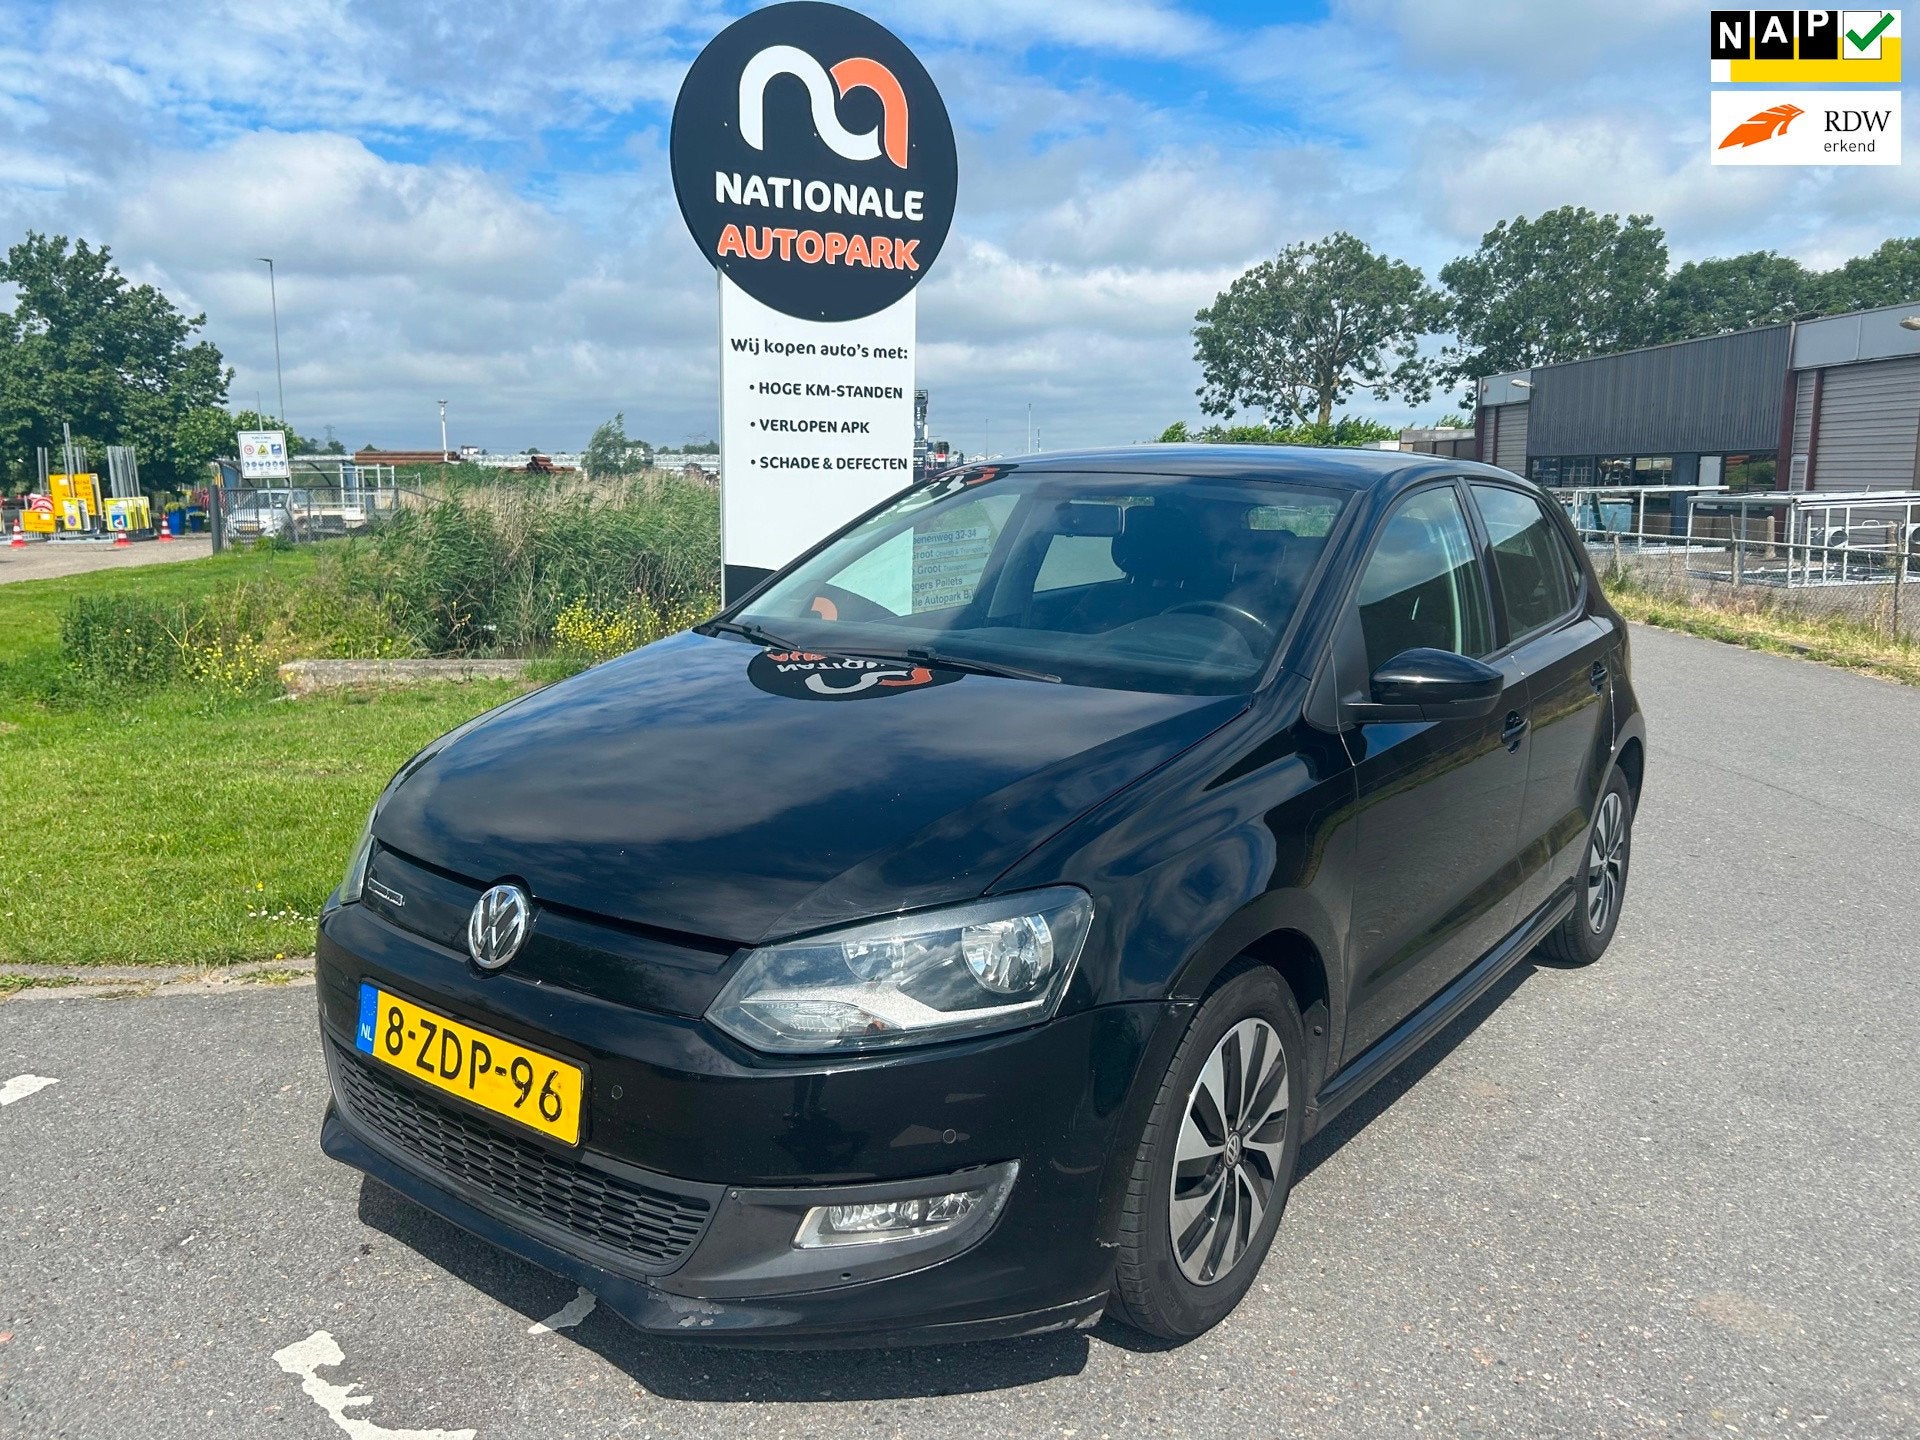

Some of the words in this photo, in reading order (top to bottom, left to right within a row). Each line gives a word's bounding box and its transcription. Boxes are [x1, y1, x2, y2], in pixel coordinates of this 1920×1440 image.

[715, 171, 924, 221] NATIONALE
[717, 223, 921, 271] AUTOPARK
[730, 337, 760, 356] Wij
[764, 339, 816, 357] kopen
[820, 343, 869, 358] auto's
[873, 346, 908, 360] met:
[758, 381, 802, 396] HOGE
[805, 383, 903, 399] KM-STANDEN
[759, 418, 838, 433] VERLOPEN
[840, 420, 870, 434] APK
[759, 456, 820, 469] SCHADE
[822, 457, 833, 470] &
[836, 457, 908, 470] DEFECTEN
[955, 529, 977, 539] 32-34
[917, 565, 941, 575] Groot
[935, 577, 963, 588] Pallets
[925, 591, 962, 605] Autopark
[360, 1022, 373, 1042] NL
[385, 1006, 563, 1123] 8-ZDP-96
